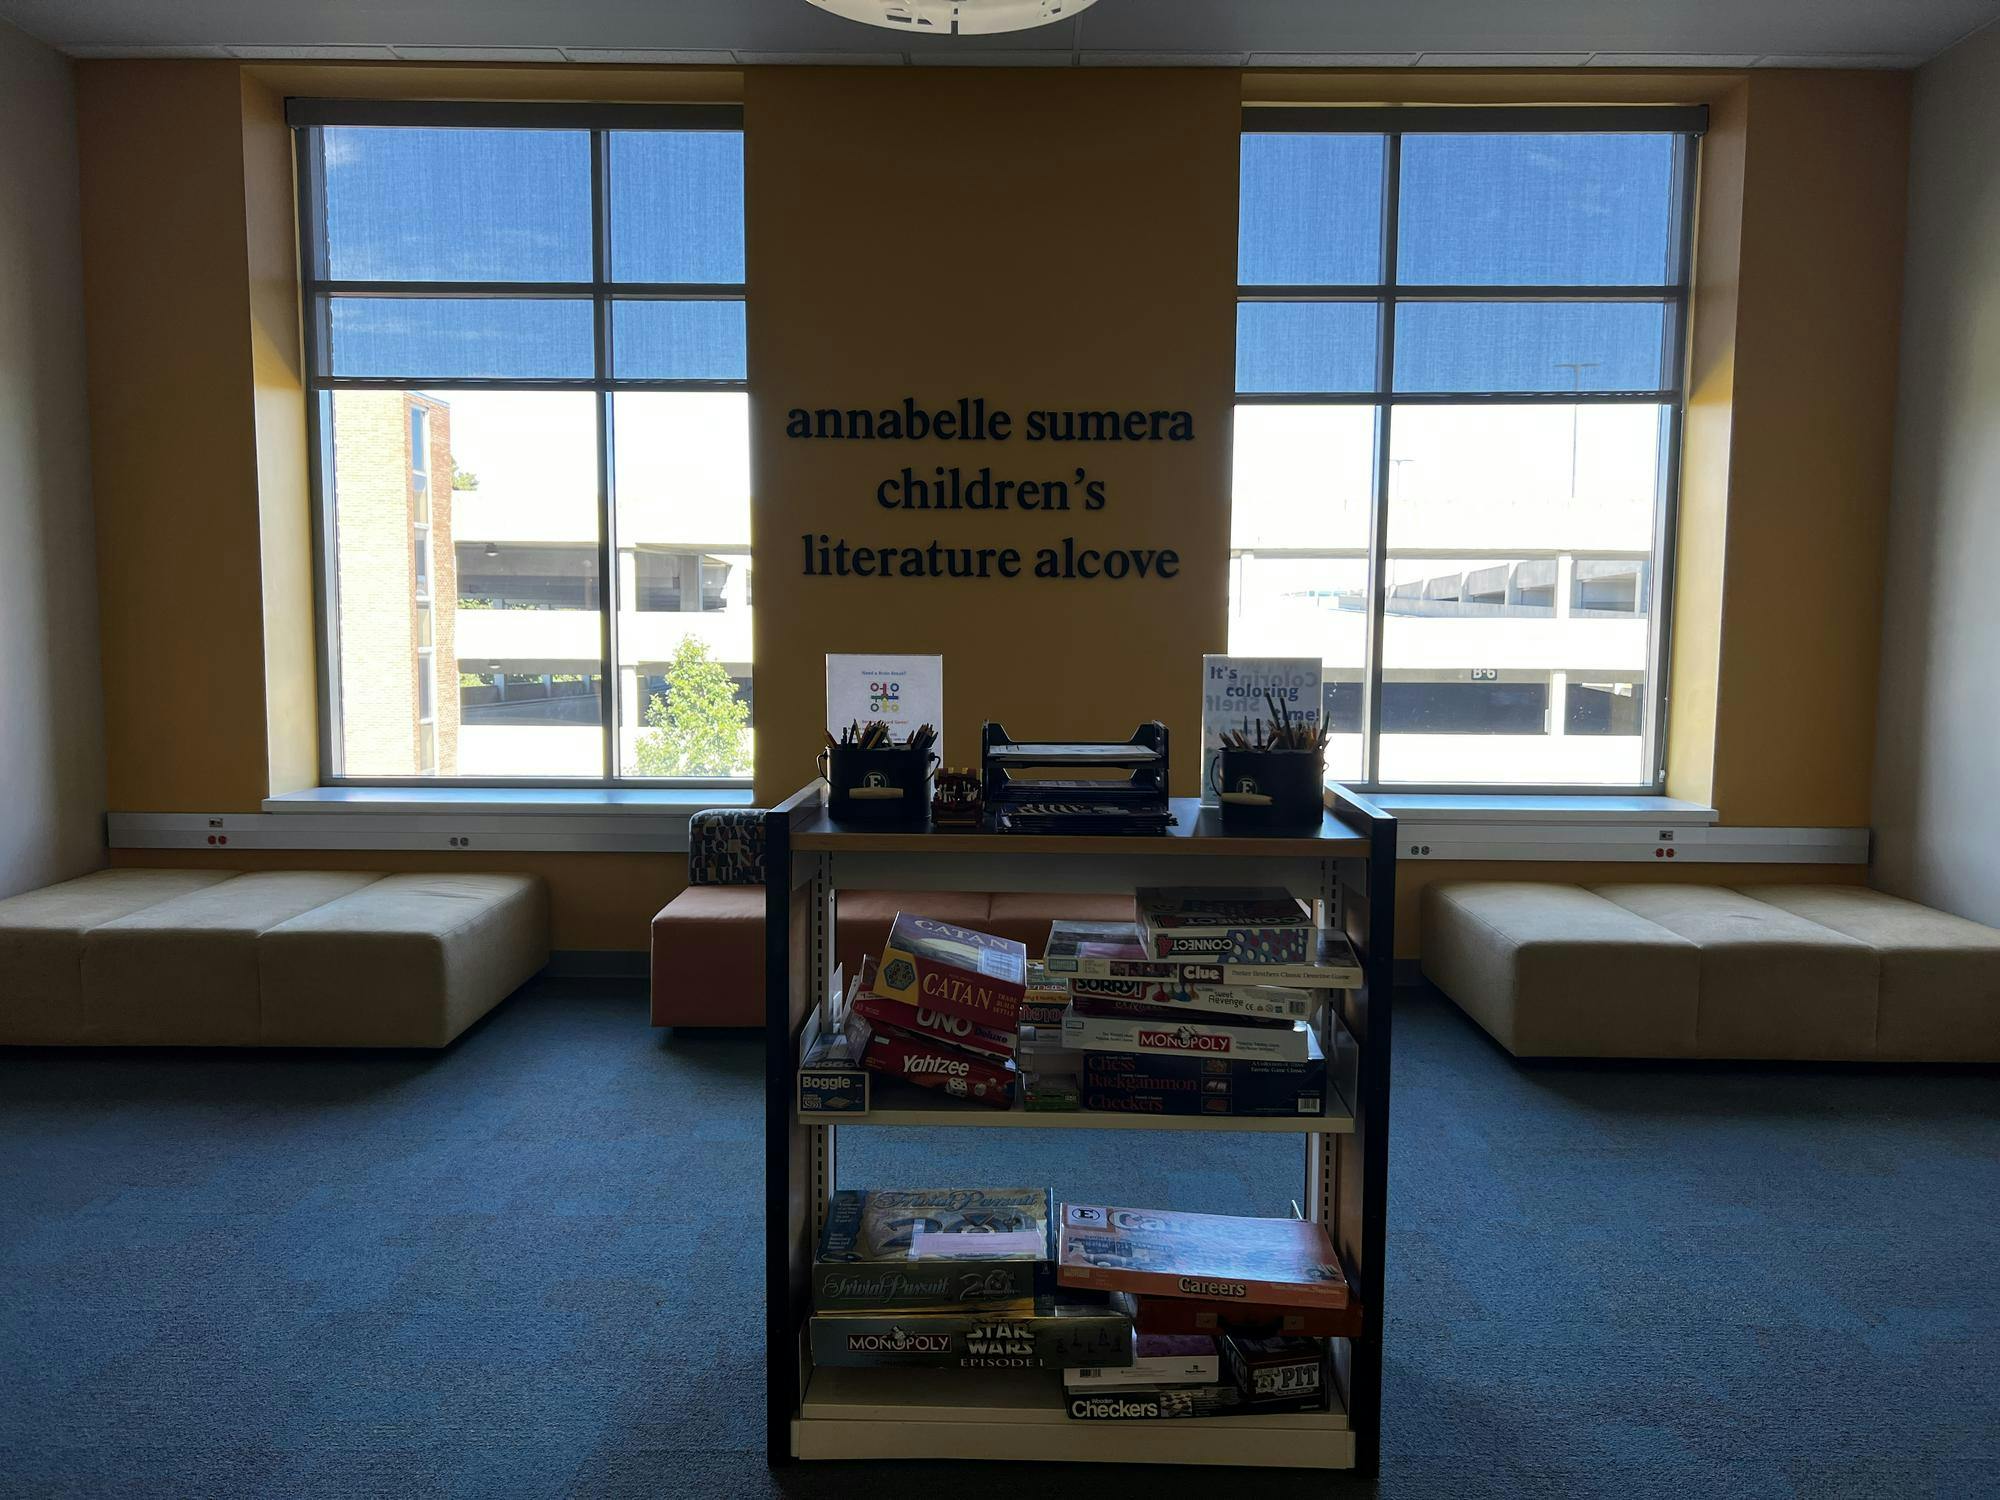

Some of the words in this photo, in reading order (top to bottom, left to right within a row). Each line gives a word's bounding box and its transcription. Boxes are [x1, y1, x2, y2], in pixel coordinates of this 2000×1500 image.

[786, 397, 1012, 441] annabelle
[1026, 408, 1196, 441] sumera
[876, 466, 1107, 511] children's
[802, 533, 1022, 578] literature
[1034, 536, 1181, 579] alcove
[1210, 666, 1238, 680] It's
[1226, 683, 1299, 702] coloring
[914, 919, 1009, 951] CATAN
[1171, 937, 1234, 951] CONNECT
[1182, 964, 1220, 981] Clue
[921, 972, 994, 1011] CATAN
[1076, 978, 1142, 997] SORRY!
[916, 1007, 973, 1038] UNO
[1139, 1033, 1230, 1052] MONOPOLY
[902, 1054, 970, 1077] Yahtzee
[802, 1076, 852, 1090] Boggle
[1088, 1073, 1199, 1092] Backgammon
[1078, 1208, 1095, 1219] E
[1177, 1276, 1247, 1297] Careers
[965, 1321, 1036, 1340] STAR
[848, 1334, 950, 1352] MONOPOLY
[965, 1339, 1034, 1355] WARS
[960, 1357, 1033, 1368] EPISODE
[1281, 1364, 1319, 1389] PIT
[1071, 1399, 1159, 1419] Checkers
